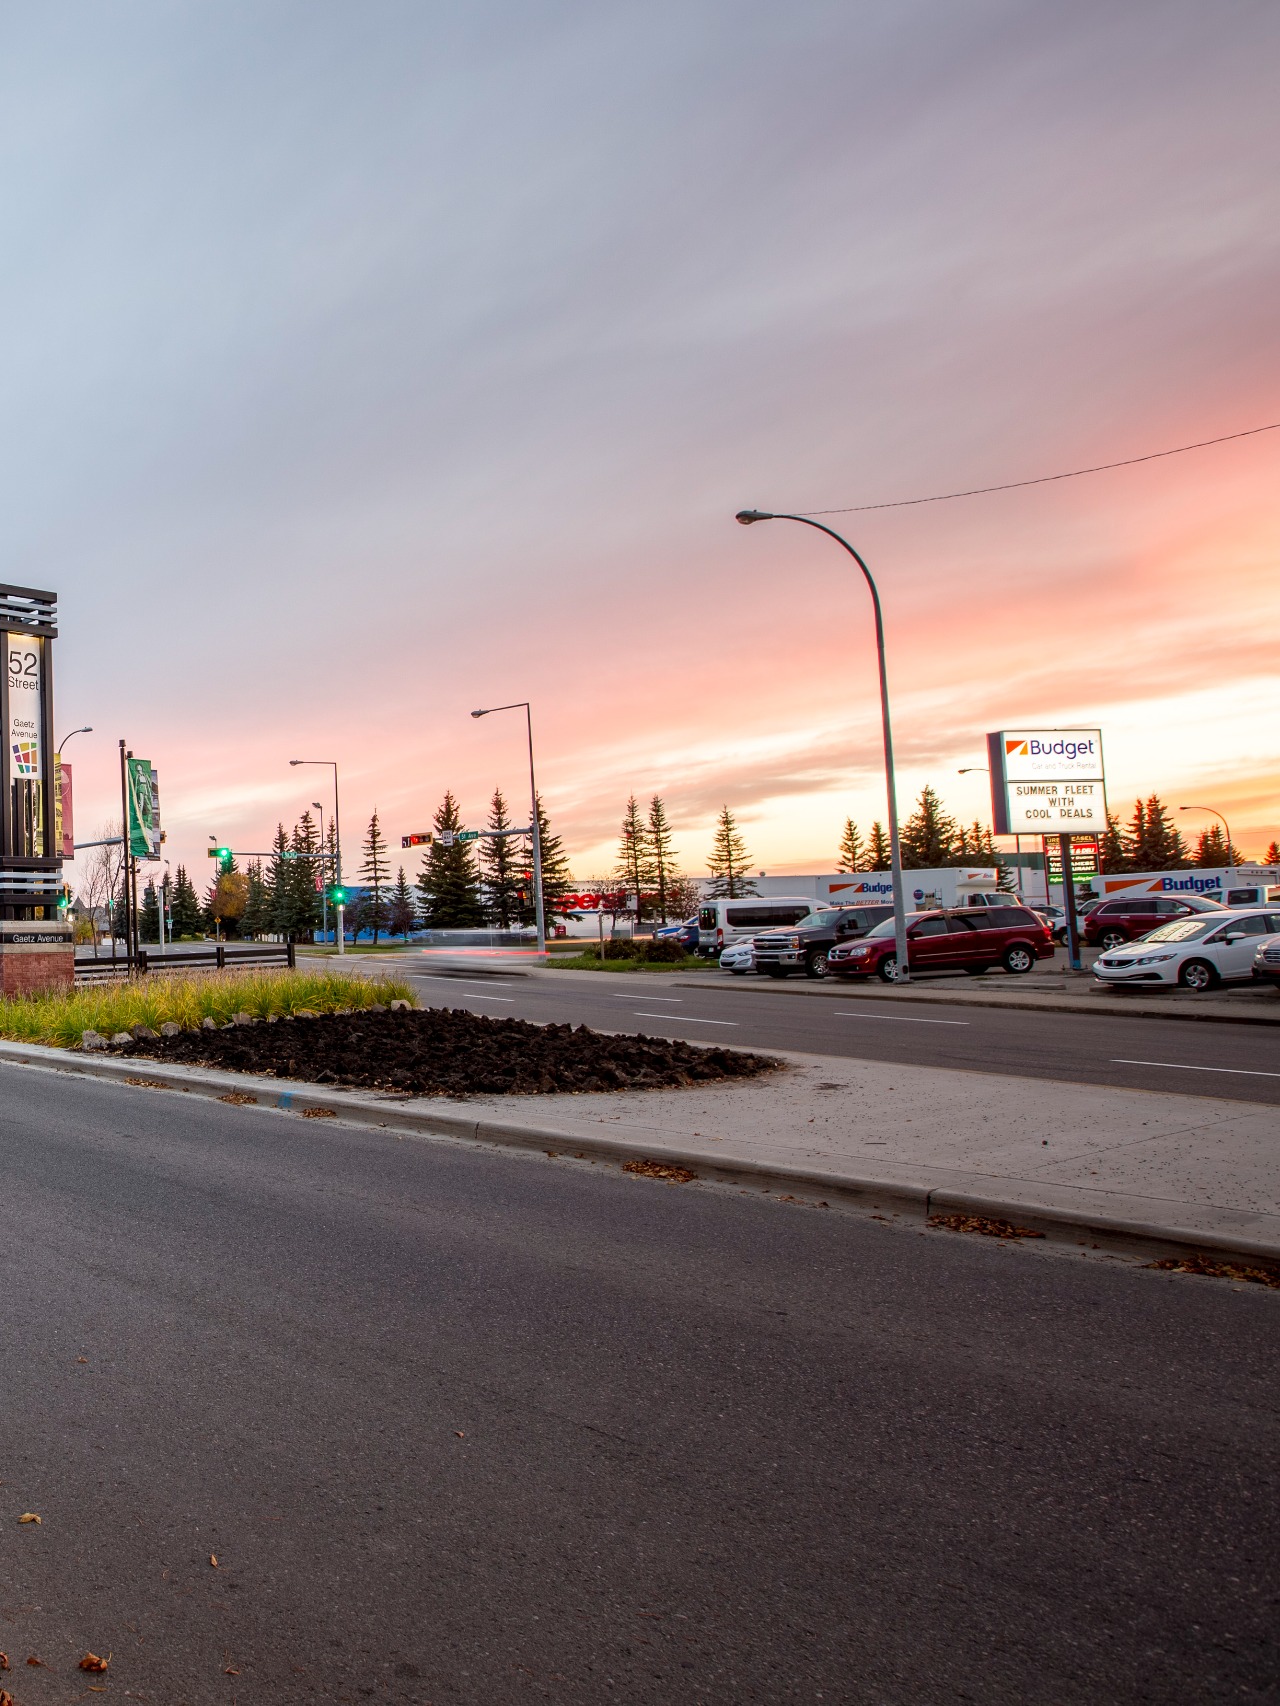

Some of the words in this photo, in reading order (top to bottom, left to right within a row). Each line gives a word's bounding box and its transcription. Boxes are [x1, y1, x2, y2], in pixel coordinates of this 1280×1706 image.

[8, 650, 38, 677] 52
[8, 676, 39, 691] Street
[13, 718, 35, 729] Gaetz
[11, 729, 38, 739] Avenue
[1030, 739, 1095, 760] Budget
[1016, 786, 1058, 796] SUMMER
[1065, 785, 1095, 794] FLEET
[1048, 797, 1075, 806] WITH
[1025, 809, 1052, 818] COOL
[1060, 808, 1093, 818] DEALS
[861, 882, 893, 894] Budge
[1162, 876, 1222, 893] Budget
[12, 934, 35, 943] Gaetz
[36, 934, 64, 943] Avenue
